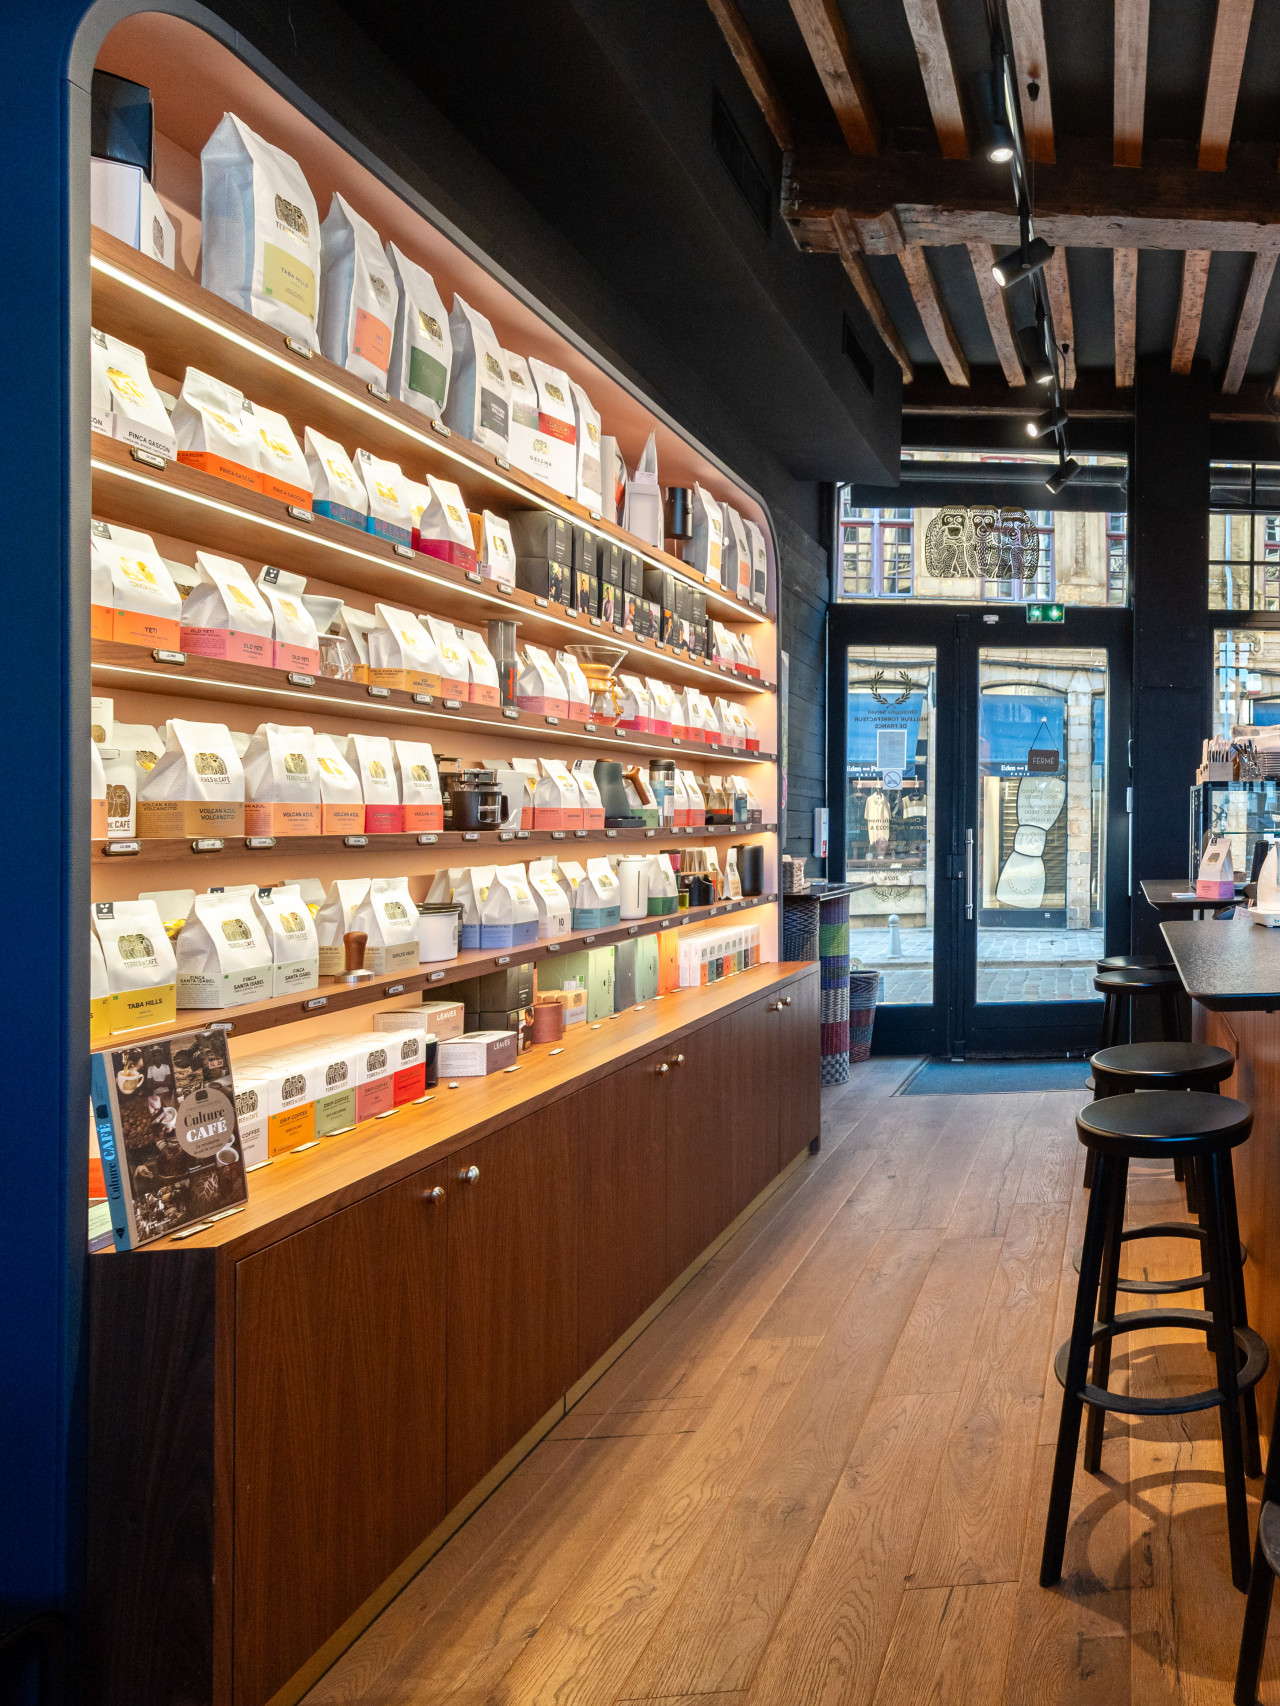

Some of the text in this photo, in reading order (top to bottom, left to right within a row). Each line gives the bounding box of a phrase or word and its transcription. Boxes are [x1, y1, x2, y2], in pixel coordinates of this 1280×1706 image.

[281, 267, 309, 288] TABA HILLS
[129, 432, 147, 443] FINCA
[148, 439, 170, 453] GASCON
[220, 466, 254, 484] FINCA GASCON
[272, 486, 306, 502] FINCA GASCON
[145, 626, 158, 634] YETI
[1033, 757, 1054, 765] FERMÉ
[115, 819, 130, 828] CAFÉ
[558, 918, 564, 926] 10
[145, 998, 162, 1006] HILLS
[437, 1010, 456, 1021] LEAVES
[494, 1039, 510, 1051] LEAVES
[375, 1082, 387, 1090] COFFEE
[282, 1100, 295, 1108] TERRES
[335, 1096, 349, 1105] COFFEE
[184, 1109, 224, 1127] Culture
[280, 1111, 307, 1124] DRIP COFFEE
[187, 1117, 227, 1142] CAFÉ
[242, 1128, 260, 1138] COFFEE
[97, 1123, 121, 1200] Culture CAFÉ
